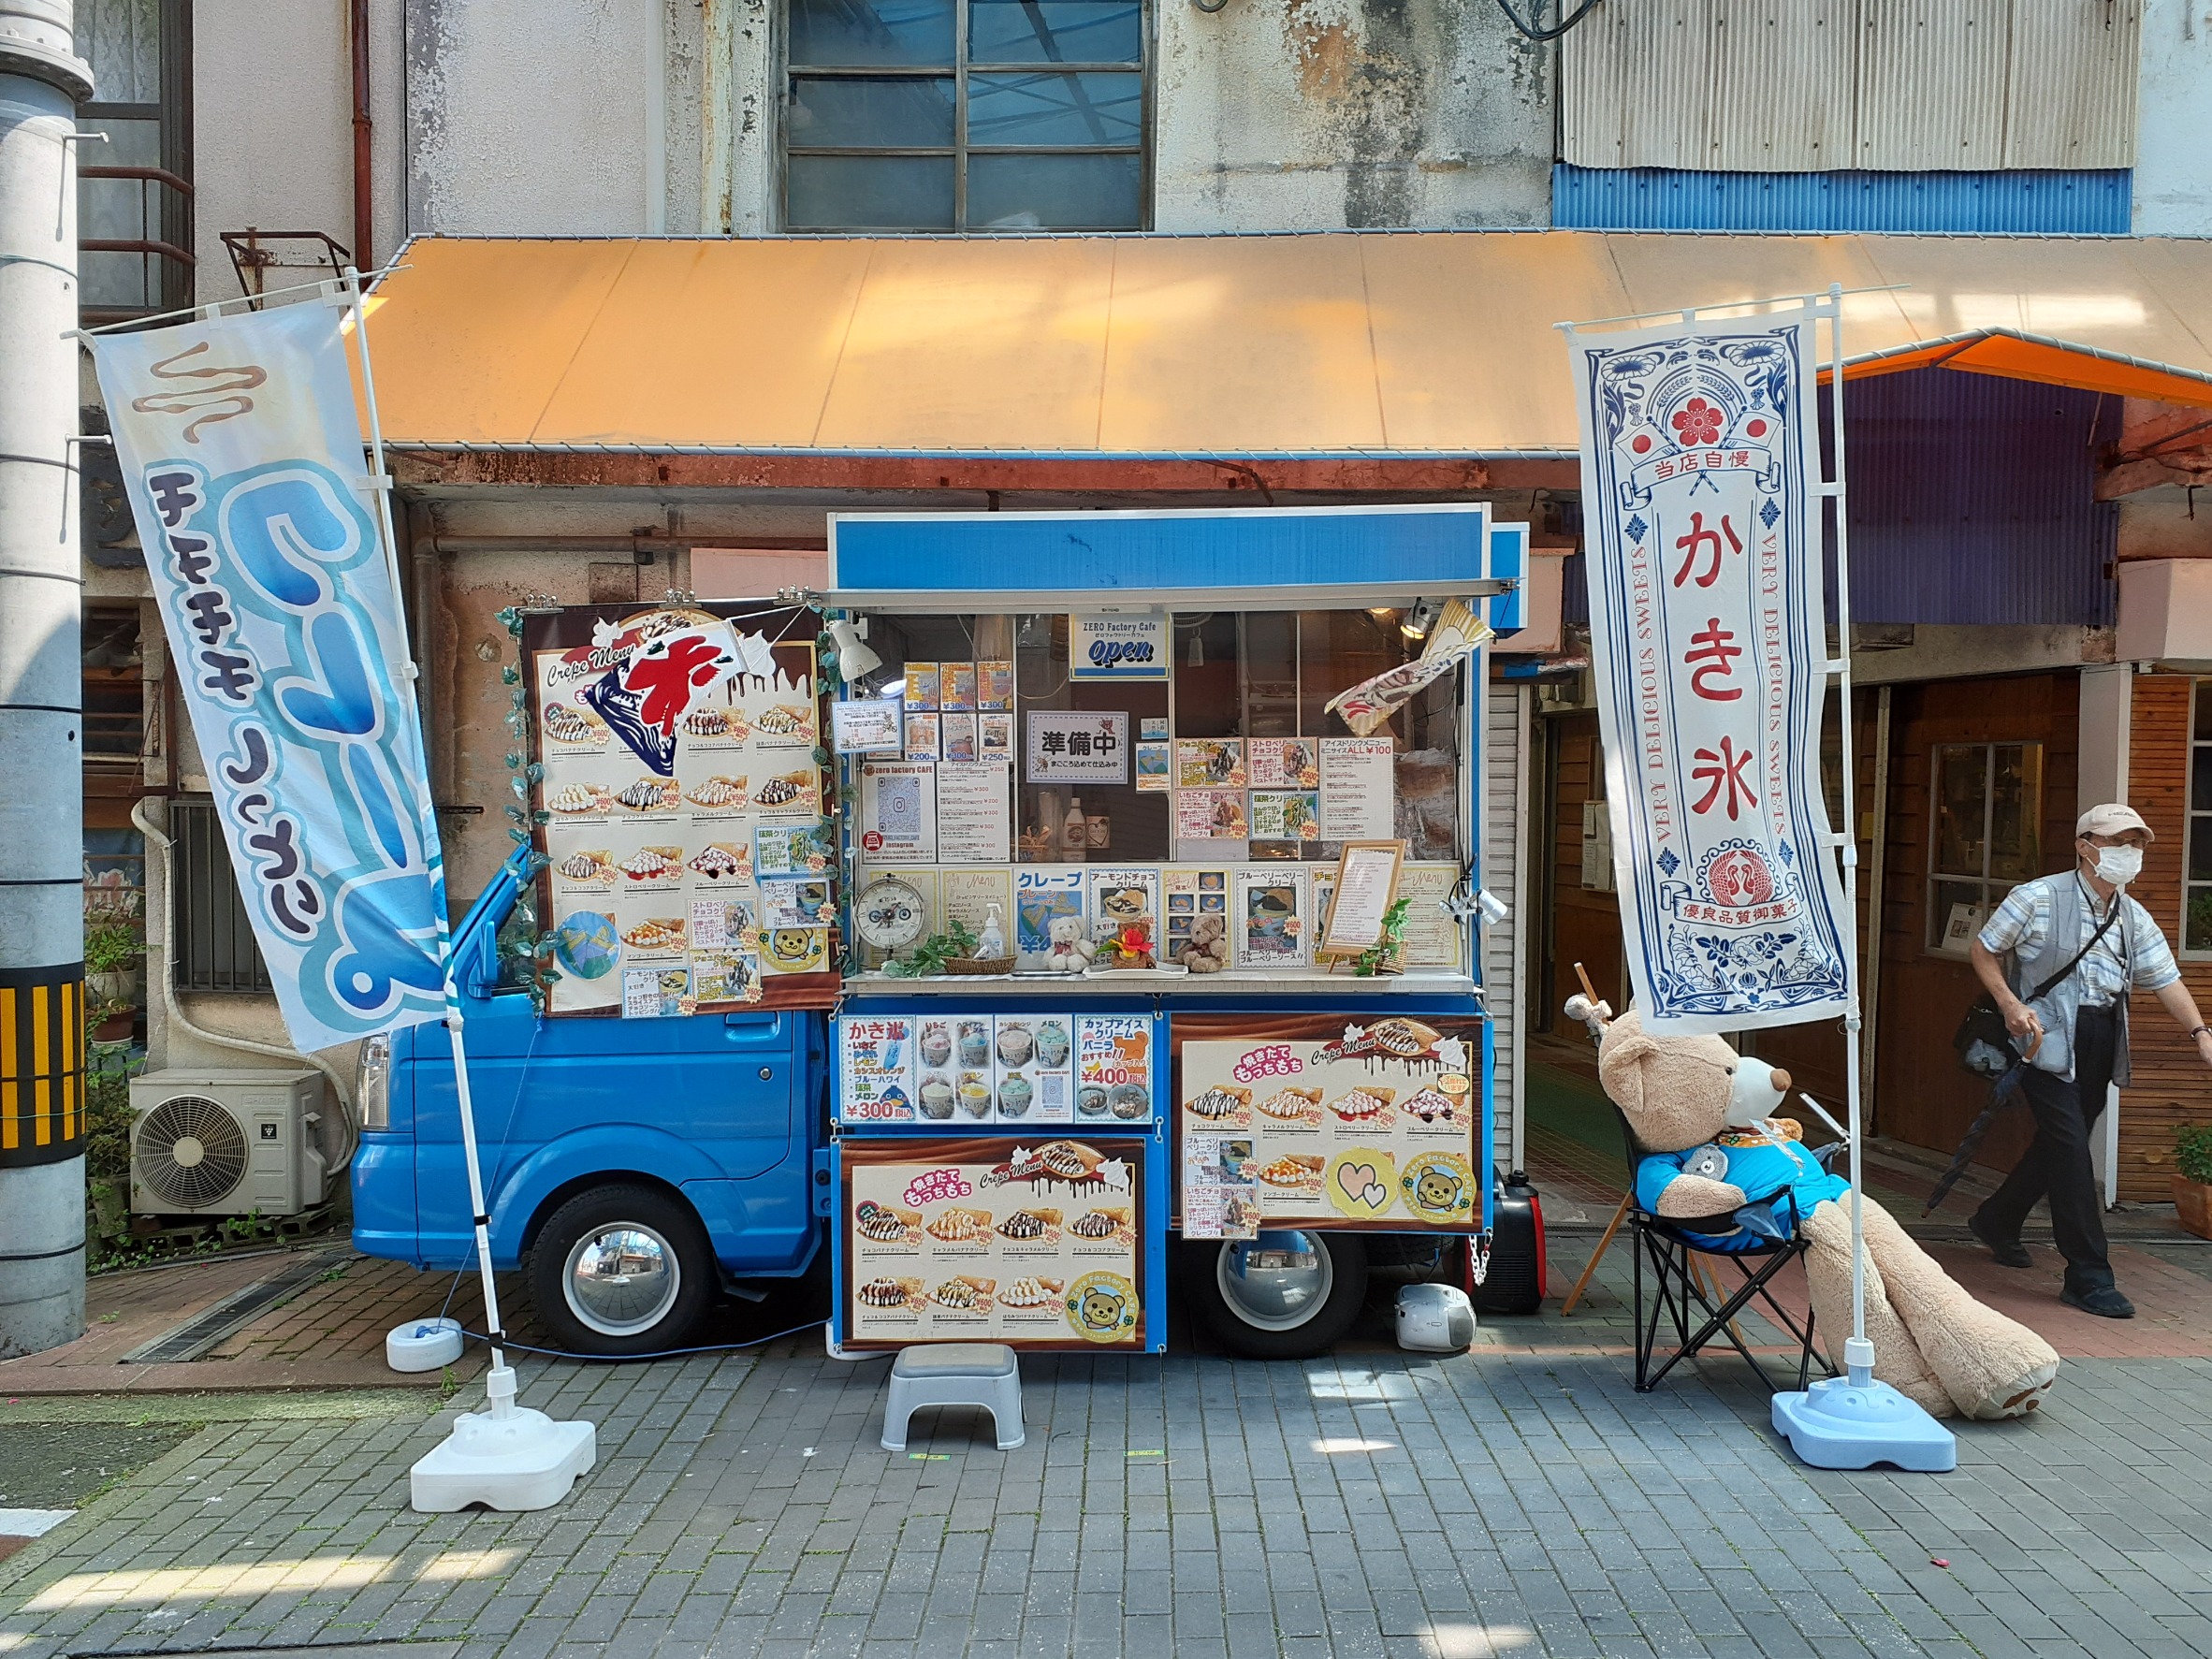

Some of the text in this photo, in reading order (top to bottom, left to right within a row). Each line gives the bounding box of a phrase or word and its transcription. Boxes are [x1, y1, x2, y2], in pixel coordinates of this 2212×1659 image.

[1655, 450, 1751, 481] 当店自慢
[1083, 621, 1157, 633] ZERO Factory Cafe
[1088, 639, 1155, 669] Open
[547, 644, 636, 688] Crepe Menu
[1672, 511, 1759, 822] かき氷
[1761, 532, 1787, 836] VERY DELICIOUS SWEETS
[1631, 546, 1672, 844] VERY DELICIOUS SWEETS
[906, 702, 929, 710] ¥300
[943, 702, 966, 710] ¥300
[1041, 731, 1116, 756] 準備中
[1346, 746, 1365, 754] ALL
[1365, 746, 1391, 755] ¥100
[908, 752, 930, 761] ¥200
[1051, 760, 1118, 768] まごころ込めて仕込み中
[891, 765, 916, 775] factory
[916, 765, 933, 774] CAFE
[967, 876, 996, 889] Menu
[1018, 871, 1083, 888] クレープ
[1091, 873, 1156, 881] アーモンドチョコ
[1116, 880, 1148, 889] クリーム
[1017, 889, 1057, 898] プレーン
[1683, 897, 1798, 925] 優良品質御菓子
[1095, 923, 1117, 931] 大好き
[848, 1021, 905, 1041] かき氷
[924, 1021, 946, 1029] いちご
[1084, 1018, 1143, 1029] カップアイス
[1095, 1029, 1134, 1039] クリーム
[852, 1041, 878, 1050] いちご
[1083, 1041, 1113, 1051] バニラ
[1311, 1037, 1376, 1065] Crepe Menu
[1243, 1046, 1290, 1069] 焼きたて
[1081, 1068, 1128, 1084] ¥400
[1234, 1058, 1302, 1082] もっちもち
[854, 1075, 900, 1084] ブルーハワイ
[846, 1101, 894, 1119] ¥300
[980, 1160, 1043, 1189] Crepe Menu
[1242, 1163, 1258, 1172] ¥600
[912, 1170, 964, 1193] 焼きたて
[1407, 1154, 1472, 1198] Zero Factory CAFE
[905, 1182, 971, 1206] もっちもち
[1088, 1273, 1127, 1291] Factory
[1124, 1290, 1136, 1314] CAFE
